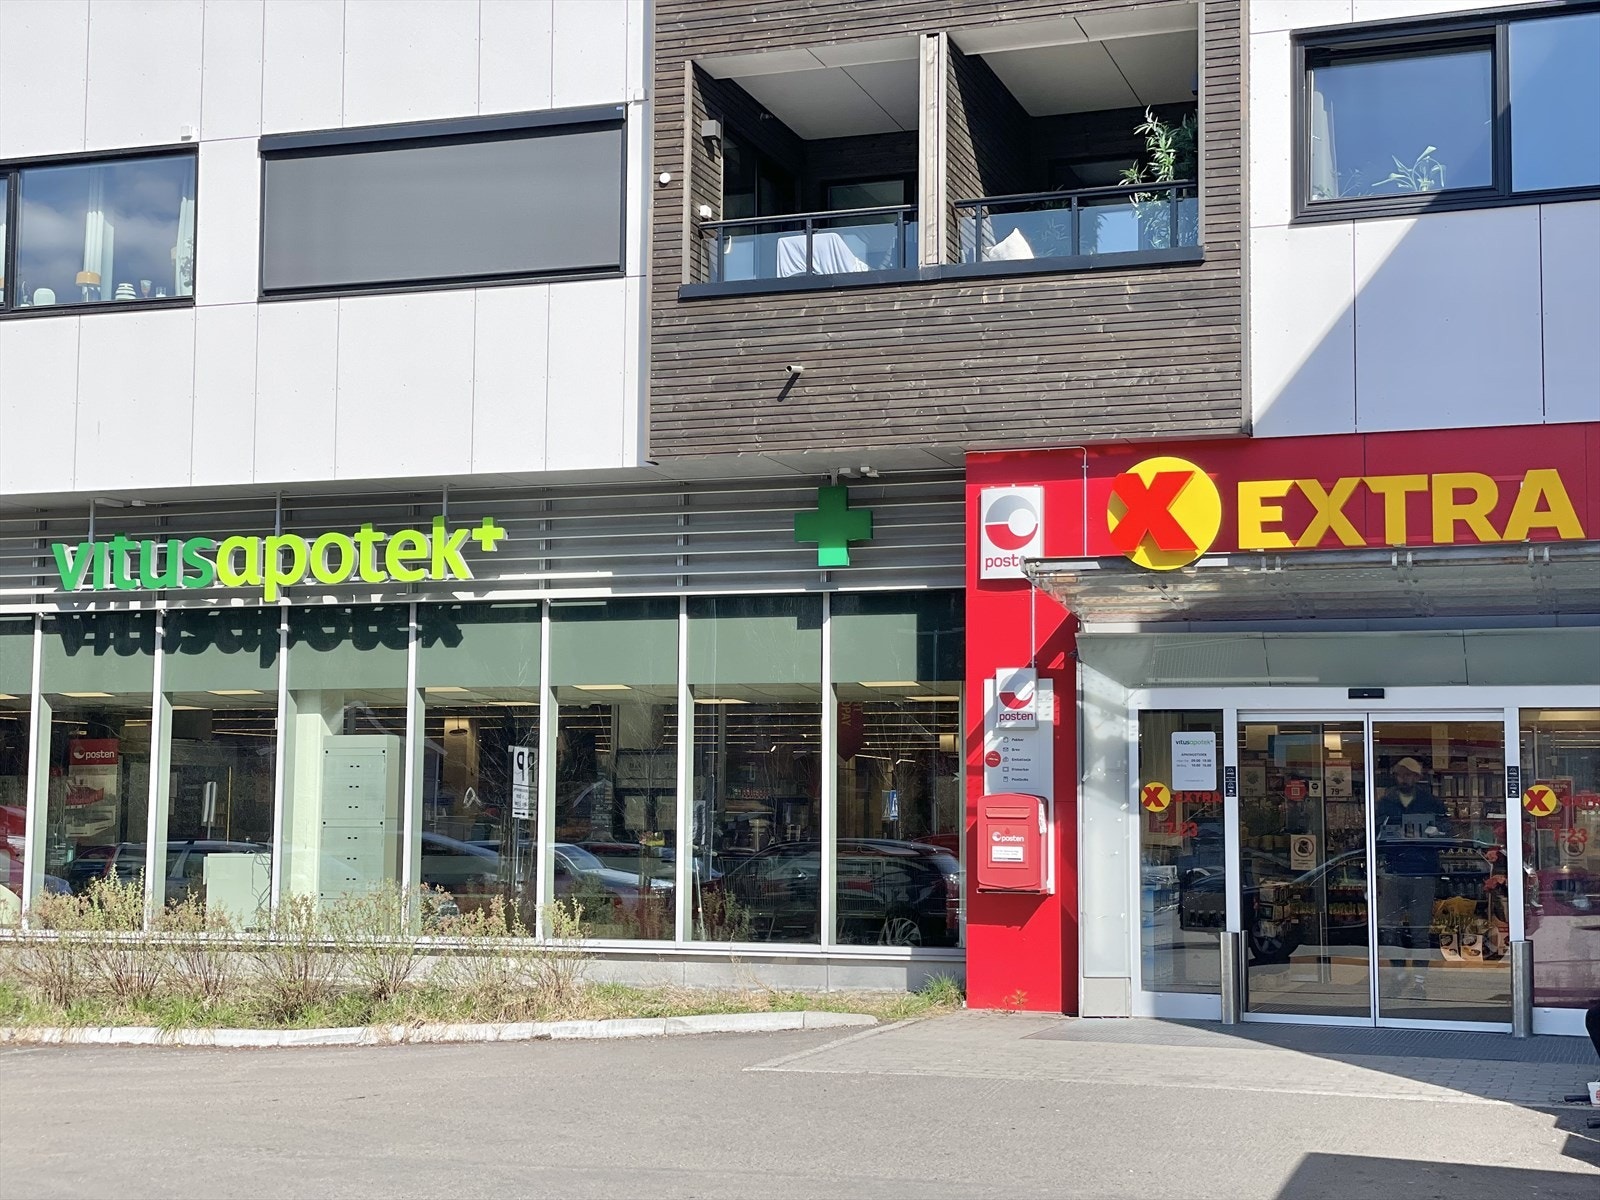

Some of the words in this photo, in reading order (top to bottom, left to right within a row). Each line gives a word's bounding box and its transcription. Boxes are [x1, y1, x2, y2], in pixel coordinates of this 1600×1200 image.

[1238, 469, 1586, 549] EXTRA
[985, 554, 1020, 571] post
[999, 712, 1034, 722] posten
[85, 750, 115, 760] posten
[1175, 791, 1223, 804] EXTRA
